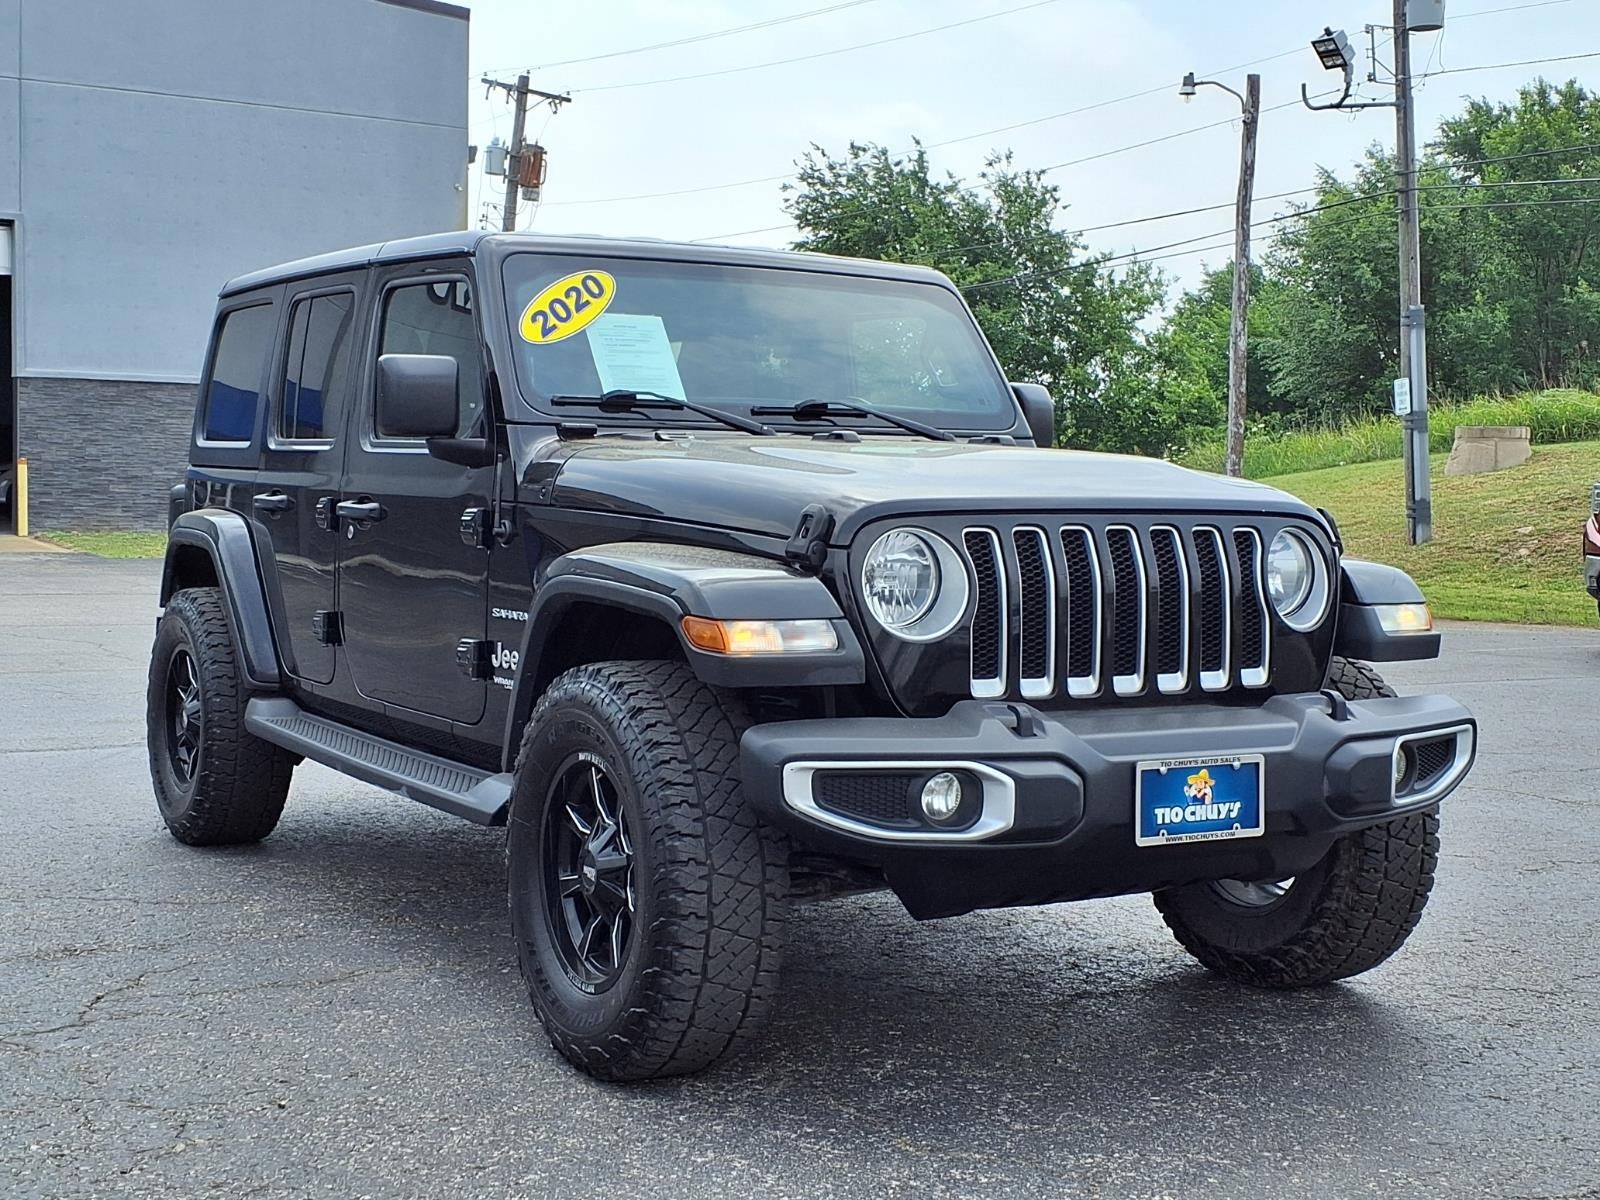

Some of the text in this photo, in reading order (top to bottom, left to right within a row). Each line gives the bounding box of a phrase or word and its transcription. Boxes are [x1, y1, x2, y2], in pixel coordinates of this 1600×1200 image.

[531, 274, 605, 339] 2020
[492, 607, 529, 621] SAHARA
[491, 642, 519, 671] Jee
[1173, 759, 1198, 767] CHUY'S
[1165, 831, 1236, 843] WWW.TIOCHUYS.COM
